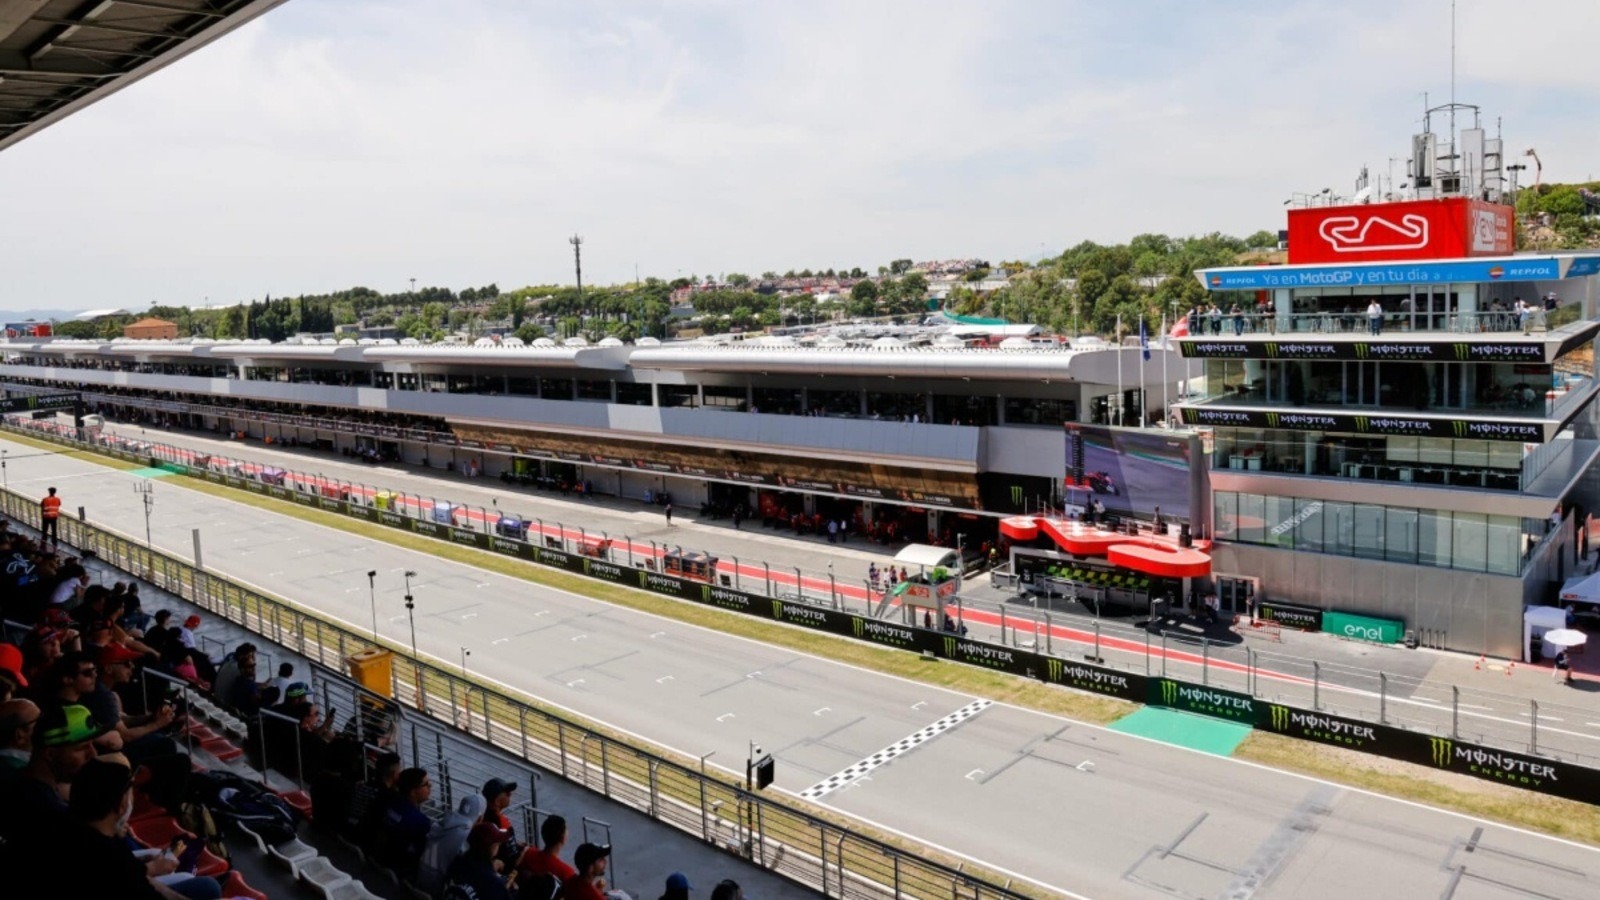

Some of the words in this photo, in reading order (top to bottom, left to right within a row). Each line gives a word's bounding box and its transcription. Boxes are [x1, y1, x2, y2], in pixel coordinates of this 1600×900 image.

[1262, 274, 1279, 285] Ya
[1281, 275, 1299, 285] en
[1300, 271, 1353, 284] MotoGP
[1356, 271, 1365, 285] y
[1368, 271, 1386, 283] en
[1388, 269, 1404, 281] tu
[1510, 267, 1551, 276] REPSOL
[1196, 343, 1248, 352] MONSTER
[1279, 344, 1336, 354] MONSTER
[1370, 345, 1433, 354] MONSTER
[1471, 345, 1541, 356] MONSTER
[1199, 411, 1250, 421] MONSTER
[1280, 415, 1336, 425] MONSTER
[1370, 419, 1431, 430] MONSTER
[1469, 424, 1538, 436] MONSTER
[647, 575, 682, 589] MONSTER
[711, 589, 750, 605] MONSTER
[783, 605, 827, 622] MONSTER
[1273, 612, 1316, 623] MONSTER
[864, 622, 914, 642] MONSTER
[1343, 624, 1383, 641] enel
[957, 642, 1014, 663] MONSTER
[1063, 664, 1128, 689] MONSTER
[1073, 679, 1118, 693] ENERGY
[1179, 686, 1253, 712] MONSTER
[1190, 701, 1241, 717] ENERGY
[1291, 713, 1376, 741] MONSTER
[1303, 729, 1363, 746] ENERGY
[1455, 746, 1558, 781] MONSTER
[1470, 764, 1541, 786] ENERGY
